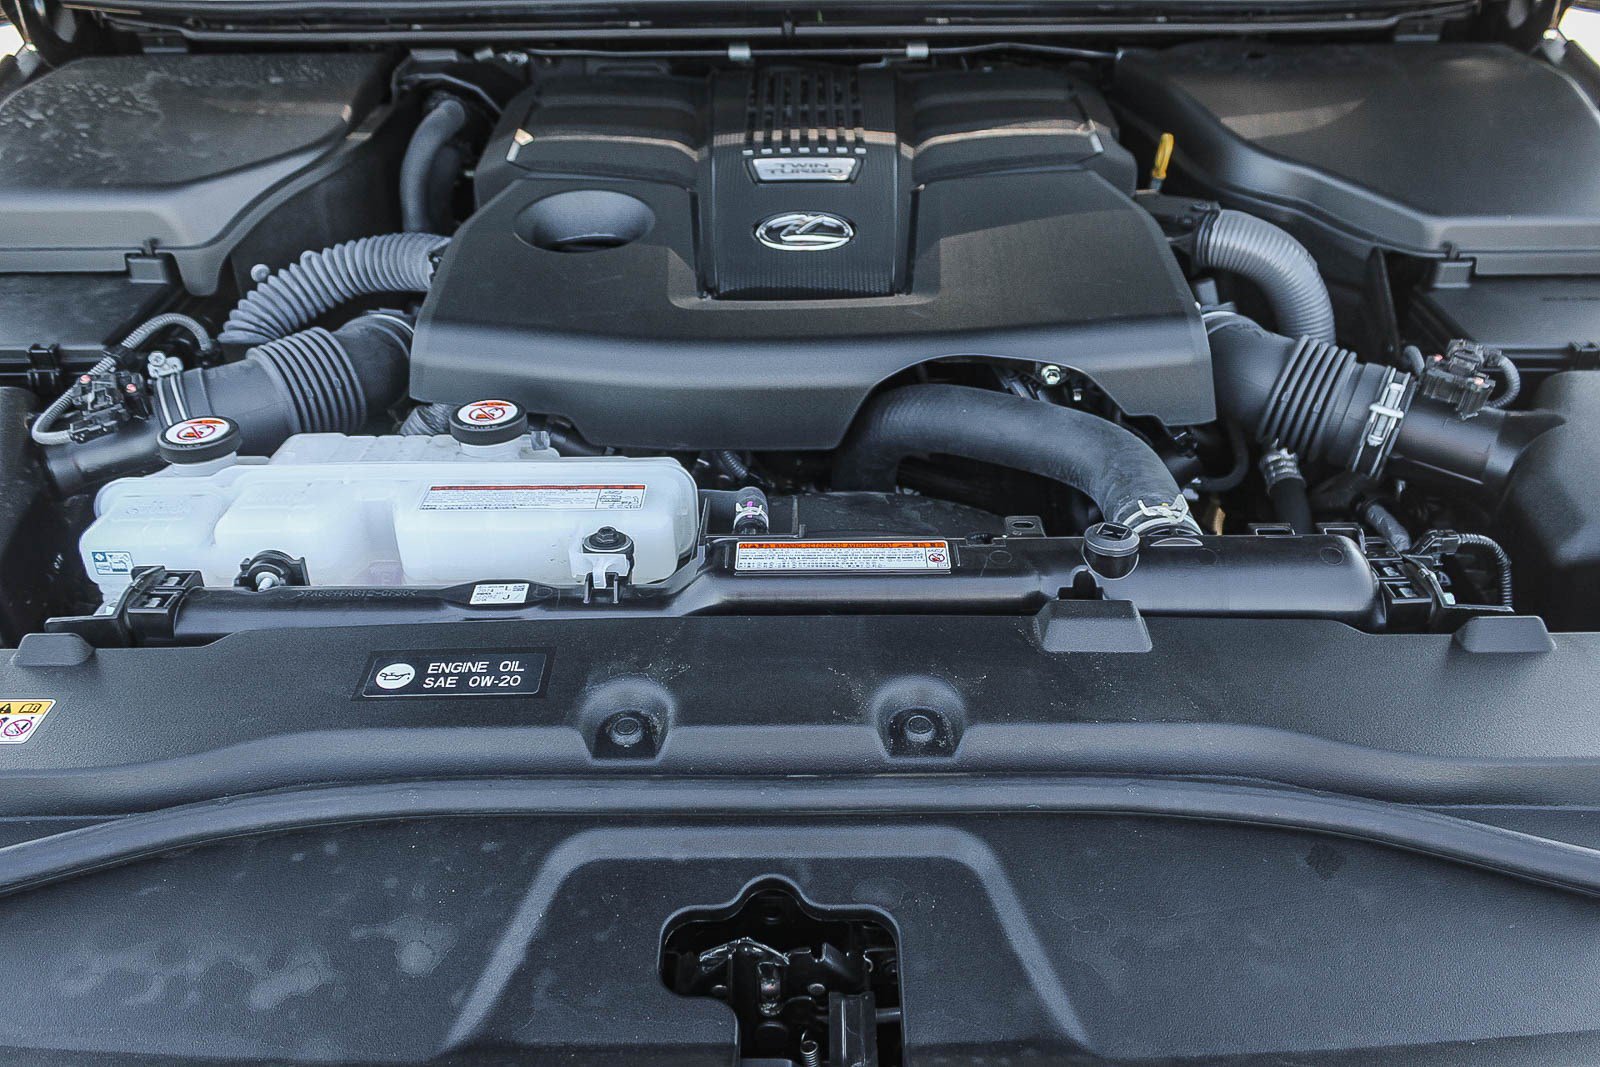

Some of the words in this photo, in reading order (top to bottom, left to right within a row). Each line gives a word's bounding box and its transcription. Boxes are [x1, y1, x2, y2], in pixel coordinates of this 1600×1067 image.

[427, 661, 490, 674] ENGINE
[499, 661, 525, 673] OIL
[423, 676, 459, 688] SAE
[468, 675, 522, 688] 0W-20
